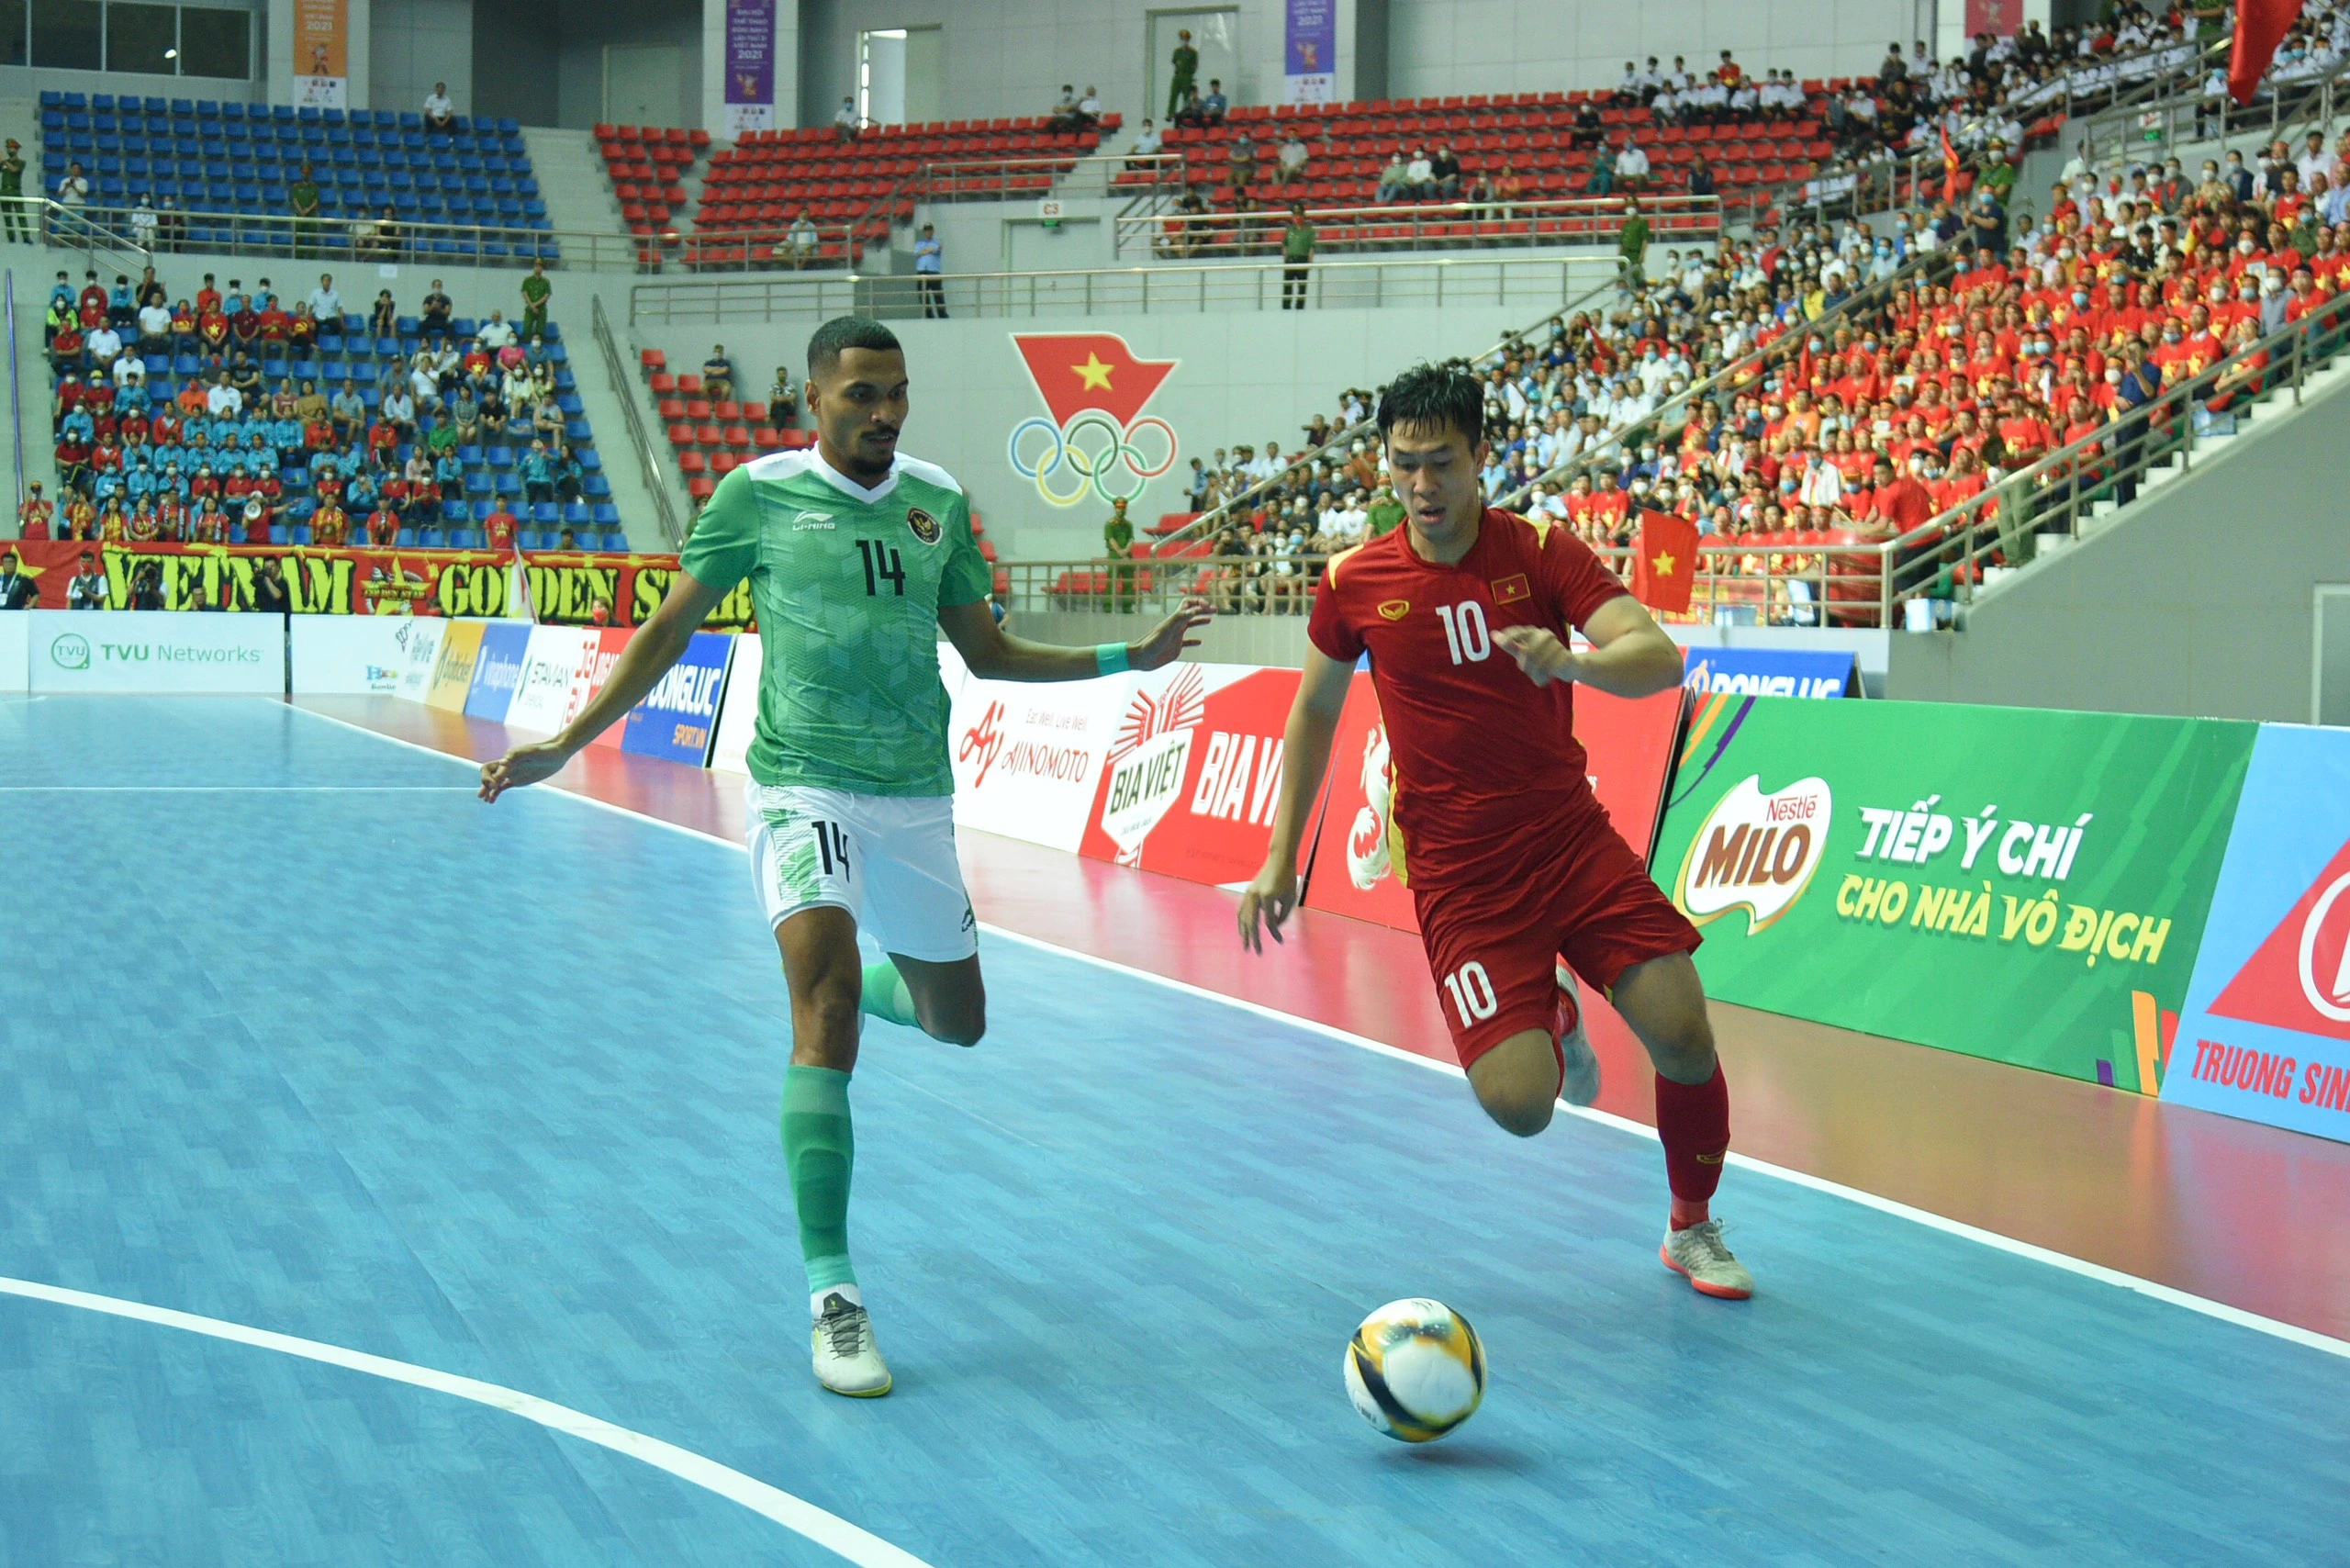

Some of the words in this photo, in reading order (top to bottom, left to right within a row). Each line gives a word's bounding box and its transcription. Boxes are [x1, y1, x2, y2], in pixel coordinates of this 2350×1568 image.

[102, 551, 355, 614] VETNAM
[856, 540, 906, 596] 14
[57, 645, 85, 655] TVU
[101, 644, 150, 661] TVU
[158, 644, 260, 662] Networks
[1436, 600, 1491, 666] 10
[1002, 741, 1089, 783] AJINOMOTO
[1109, 761, 1144, 815] BIA
[1144, 739, 1186, 801] VIỆT
[1190, 731, 1257, 822] BIA
[1766, 795, 1818, 823] Nestlé
[1855, 794, 1953, 864] TIẾP
[1961, 804, 1998, 869] Ý
[1997, 812, 2094, 880] CHÍ
[811, 821, 850, 884] 14
[1694, 823, 1811, 889] MILO
[1837, 873, 1909, 924] CHO
[1910, 879, 1993, 937] NHÀ
[1997, 888, 2059, 946] VÔ
[2056, 903, 2172, 969] ĐỊCH
[1444, 960, 1497, 1029] 10
[2191, 1039, 2297, 1099] TRUONG
[2299, 1062, 2350, 1114] SIN
